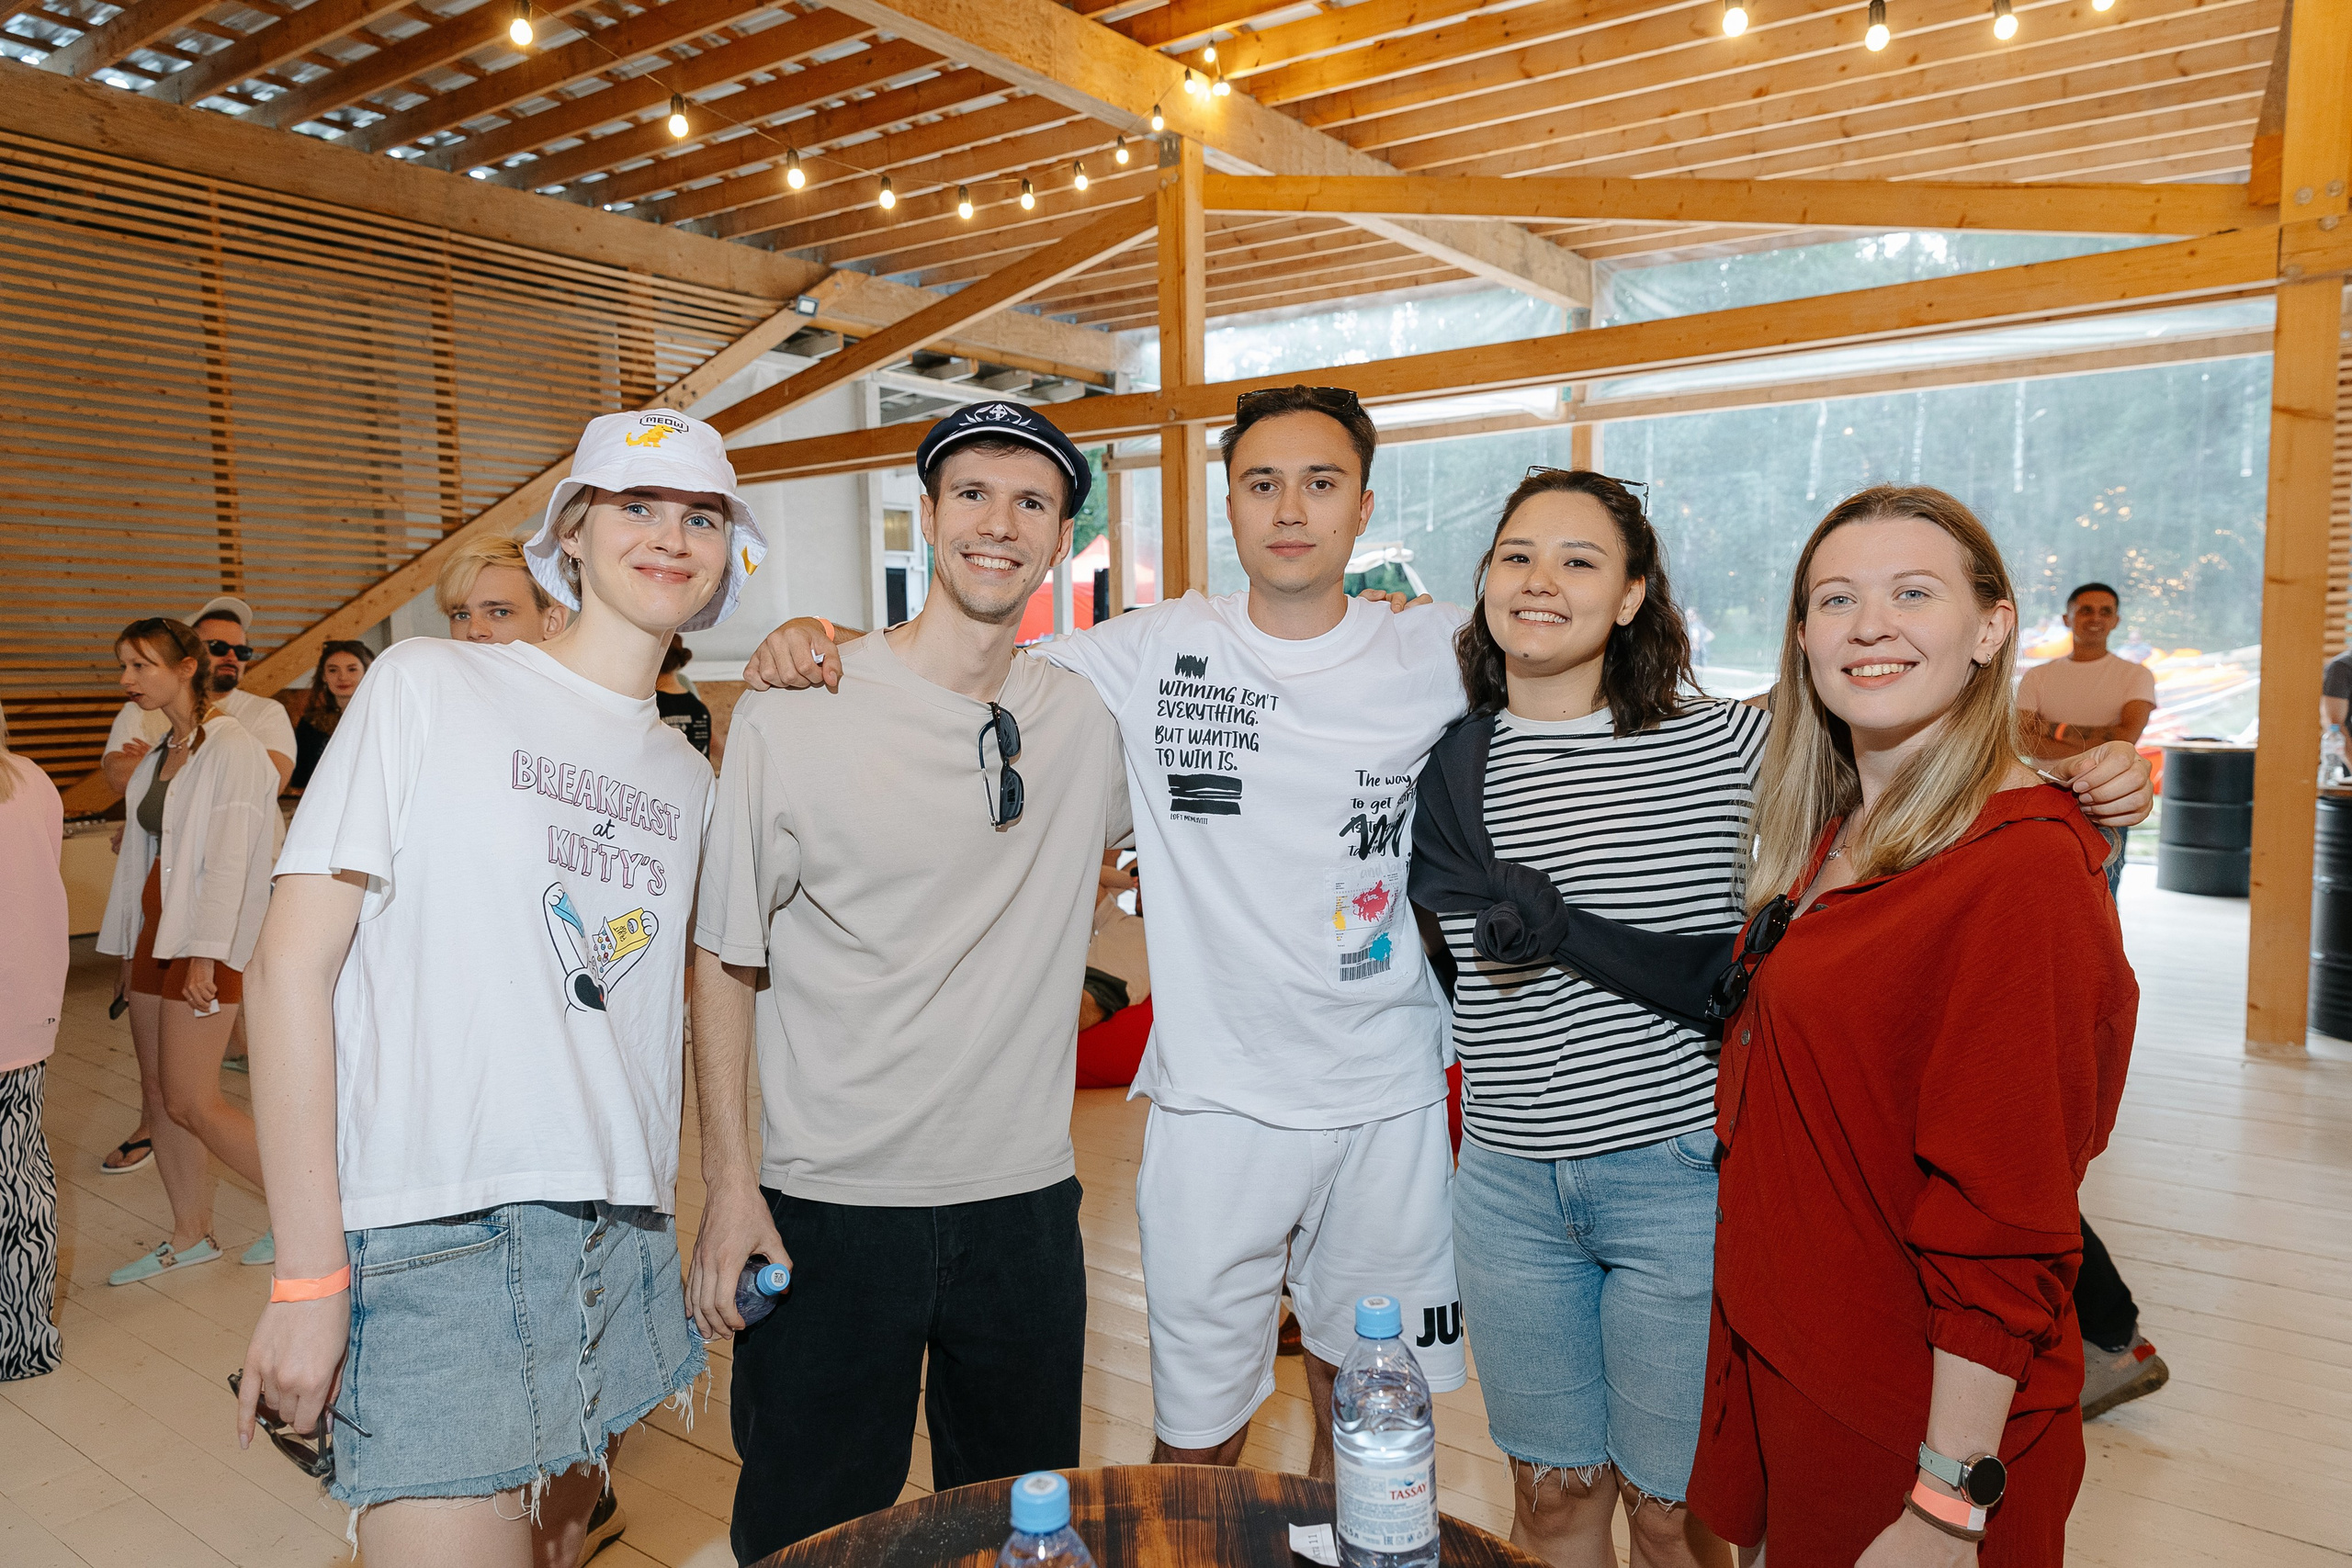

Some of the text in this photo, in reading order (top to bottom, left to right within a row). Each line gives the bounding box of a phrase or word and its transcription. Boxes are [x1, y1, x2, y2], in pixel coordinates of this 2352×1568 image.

[646, 416, 684, 428] MEOW
[1159, 678, 1280, 712] WINNING ISN'T
[1157, 699, 1259, 727] EVERYTHING.
[1155, 725, 1260, 752] BUT WANTING
[1155, 748, 1238, 771] TO WIN IS.
[1354, 770, 1412, 788] The way
[512, 749, 681, 841] BREAKFAST
[1350, 797, 1364, 809] to
[1370, 796, 1394, 815] get
[592, 818, 616, 840] at
[548, 825, 667, 897] KITTY'S
[1416, 1300, 1464, 1348] JU
[1389, 1483, 1427, 1500] TASSAY
